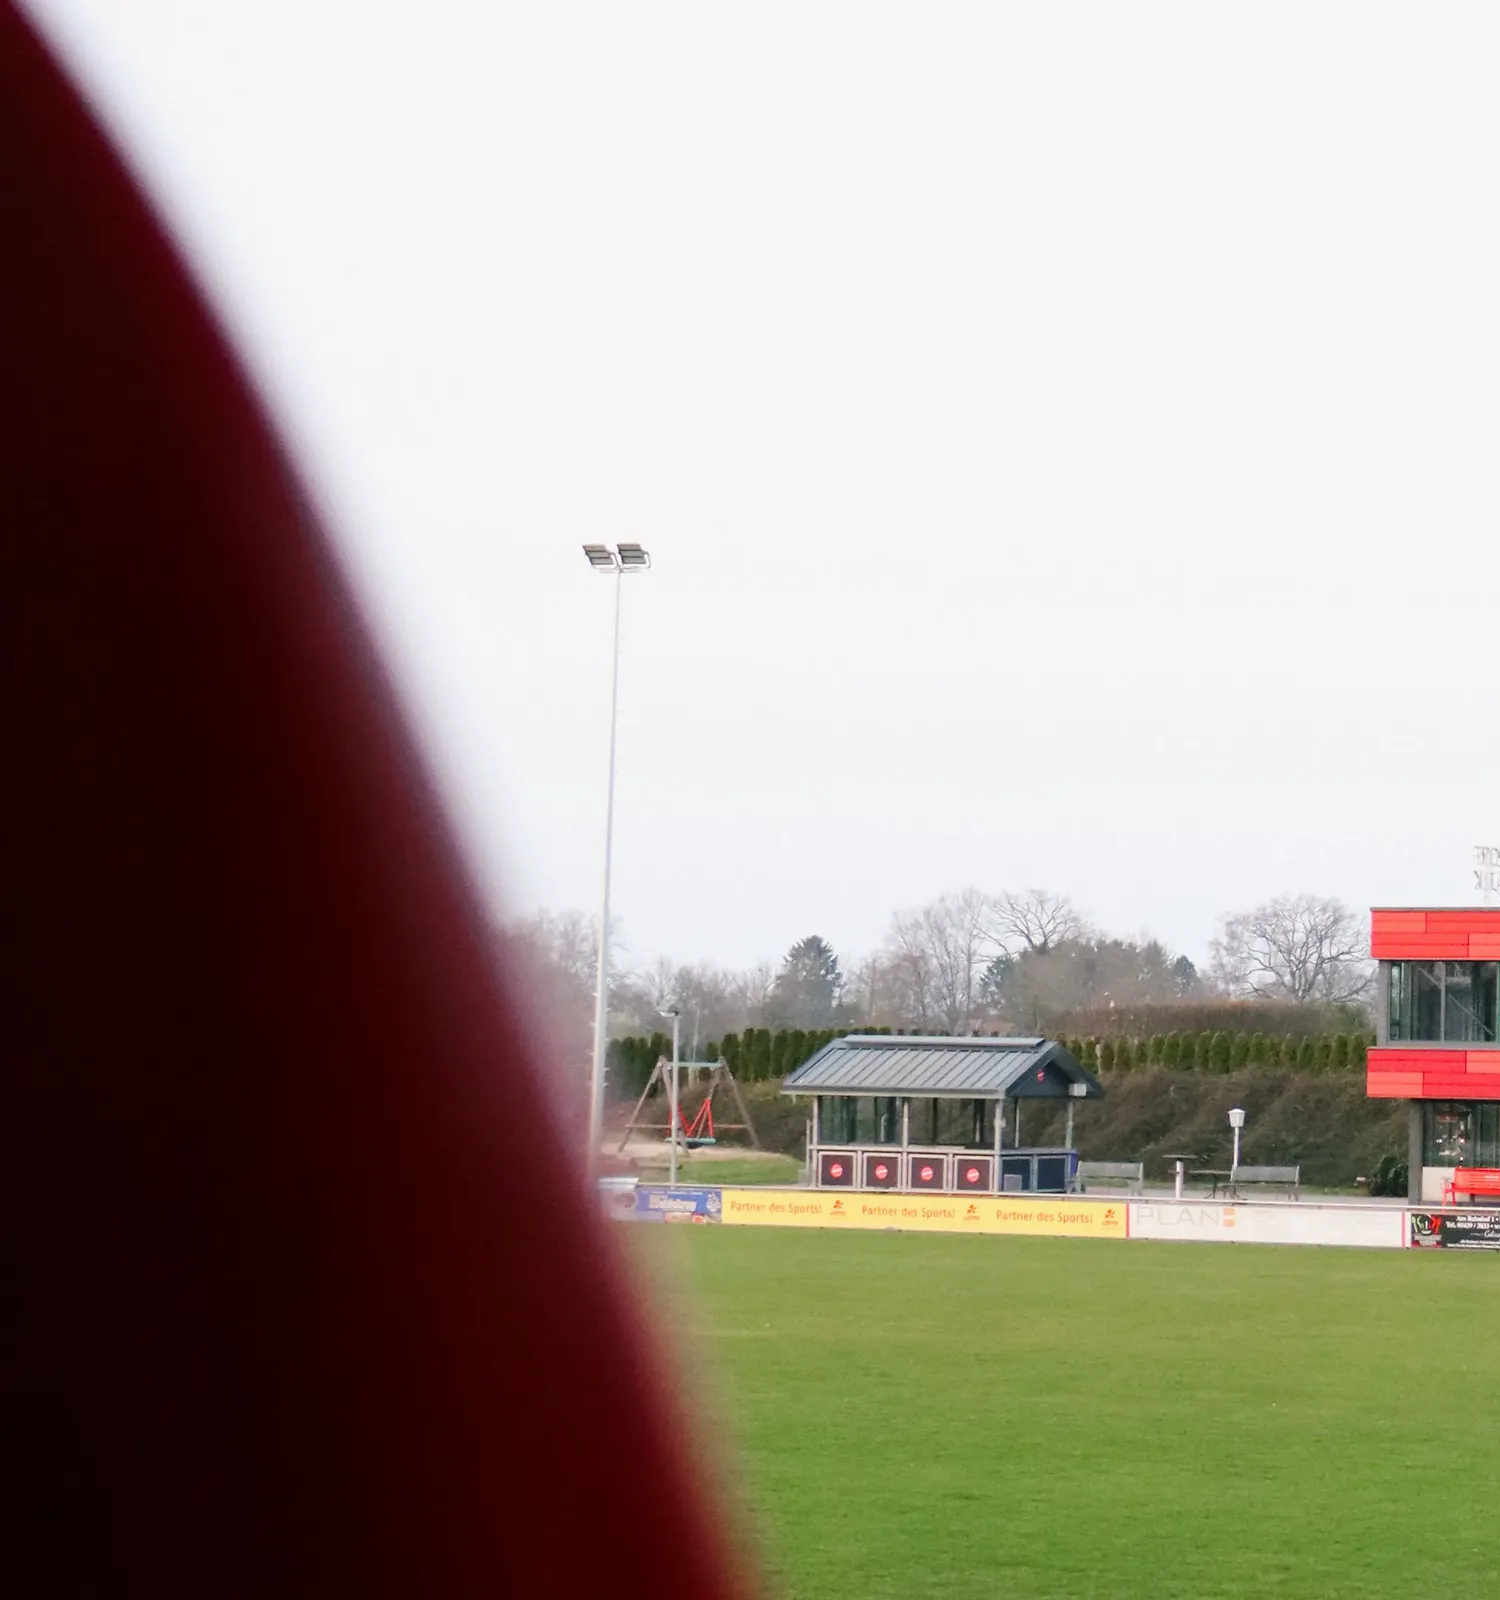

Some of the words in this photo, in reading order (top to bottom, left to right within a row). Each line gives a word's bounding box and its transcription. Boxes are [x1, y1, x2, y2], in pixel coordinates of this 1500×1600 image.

[730, 1200, 765, 1212] Partner
[768, 1202, 785, 1213] des
[788, 1203, 822, 1215] Sports!
[862, 1205, 897, 1216] Partner
[901, 1206, 918, 1217] des
[921, 1207, 955, 1219] Sports!
[996, 1209, 1033, 1221] Partner
[1036, 1211, 1054, 1222] des
[1057, 1212, 1093, 1224] Sports!
